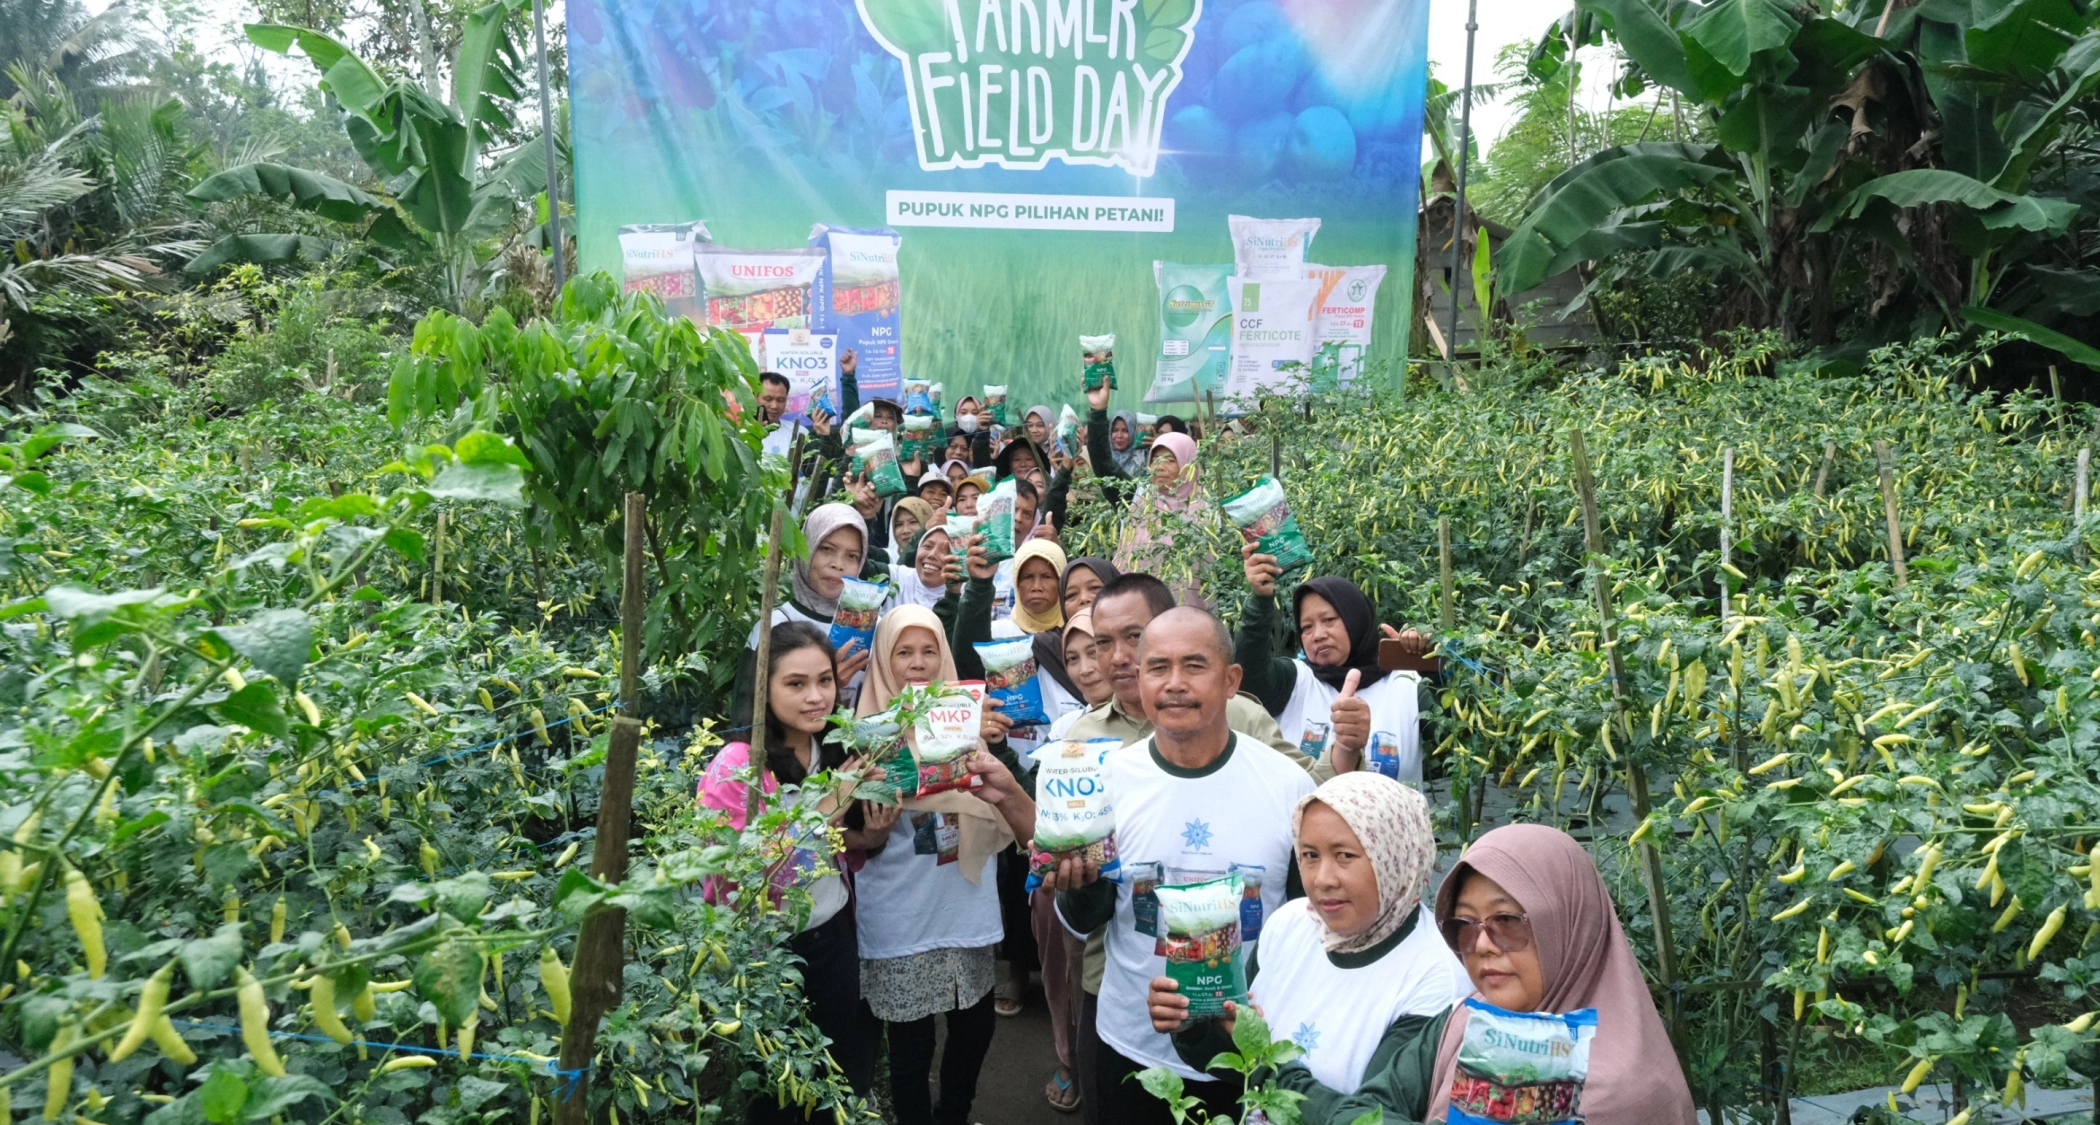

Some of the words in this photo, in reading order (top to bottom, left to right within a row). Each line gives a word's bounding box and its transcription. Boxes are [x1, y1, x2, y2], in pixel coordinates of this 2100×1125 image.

[918, 52, 1053, 157] FIELD
[1072, 63, 1168, 164] DAY
[899, 201, 964, 217] PUPUK
[970, 203, 1009, 219] NPG
[1015, 205, 1089, 220] PILIHAN
[1095, 206, 1164, 222] PETANI!
[625, 249, 674, 259] SiNutriHS
[732, 264, 794, 277] UNIFOS
[1240, 318, 1263, 329] CCF
[871, 326, 892, 337] NPG
[1239, 330, 1301, 341] FERTICOTE
[776, 357, 828, 369] KNO3
[1268, 537, 1285, 549] NPG
[1006, 693, 1024, 702] NPG
[930, 709, 971, 723] MKP
[1170, 898, 1236, 914] SiNutriHS
[1196, 975, 1223, 986] NPG
[1484, 1027, 1572, 1059] SiNutriHS
